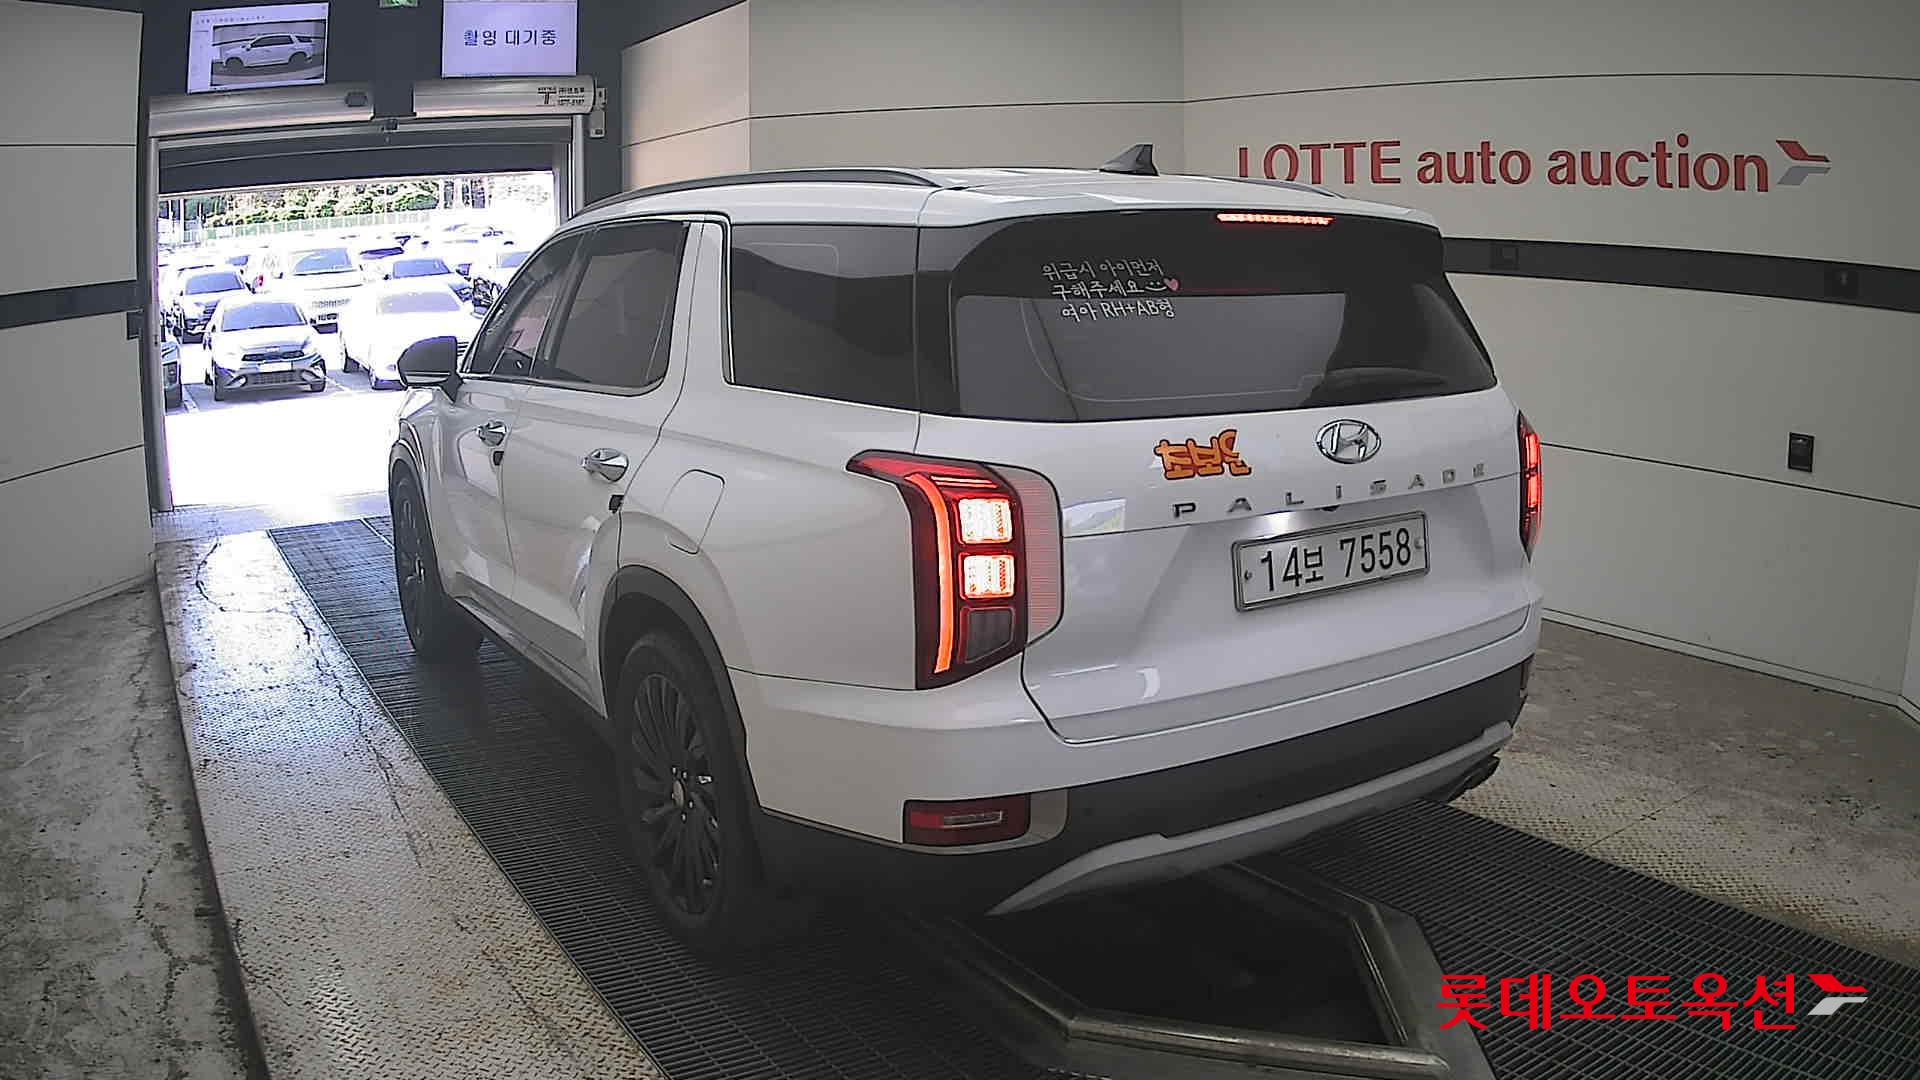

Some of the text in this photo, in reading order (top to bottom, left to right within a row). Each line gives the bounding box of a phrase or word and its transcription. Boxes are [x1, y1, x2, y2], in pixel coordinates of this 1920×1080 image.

[505, 29, 557, 46] 대기중
[1239, 133, 1769, 192] LOTTE auto auction
[1042, 258, 1164, 281] 위급시 아이먼저
[1051, 280, 1145, 301] 구해주세요
[1062, 303, 1097, 322] 여아
[1173, 462, 1486, 518] PALISADE
[1260, 527, 1412, 592] 14보 7558
